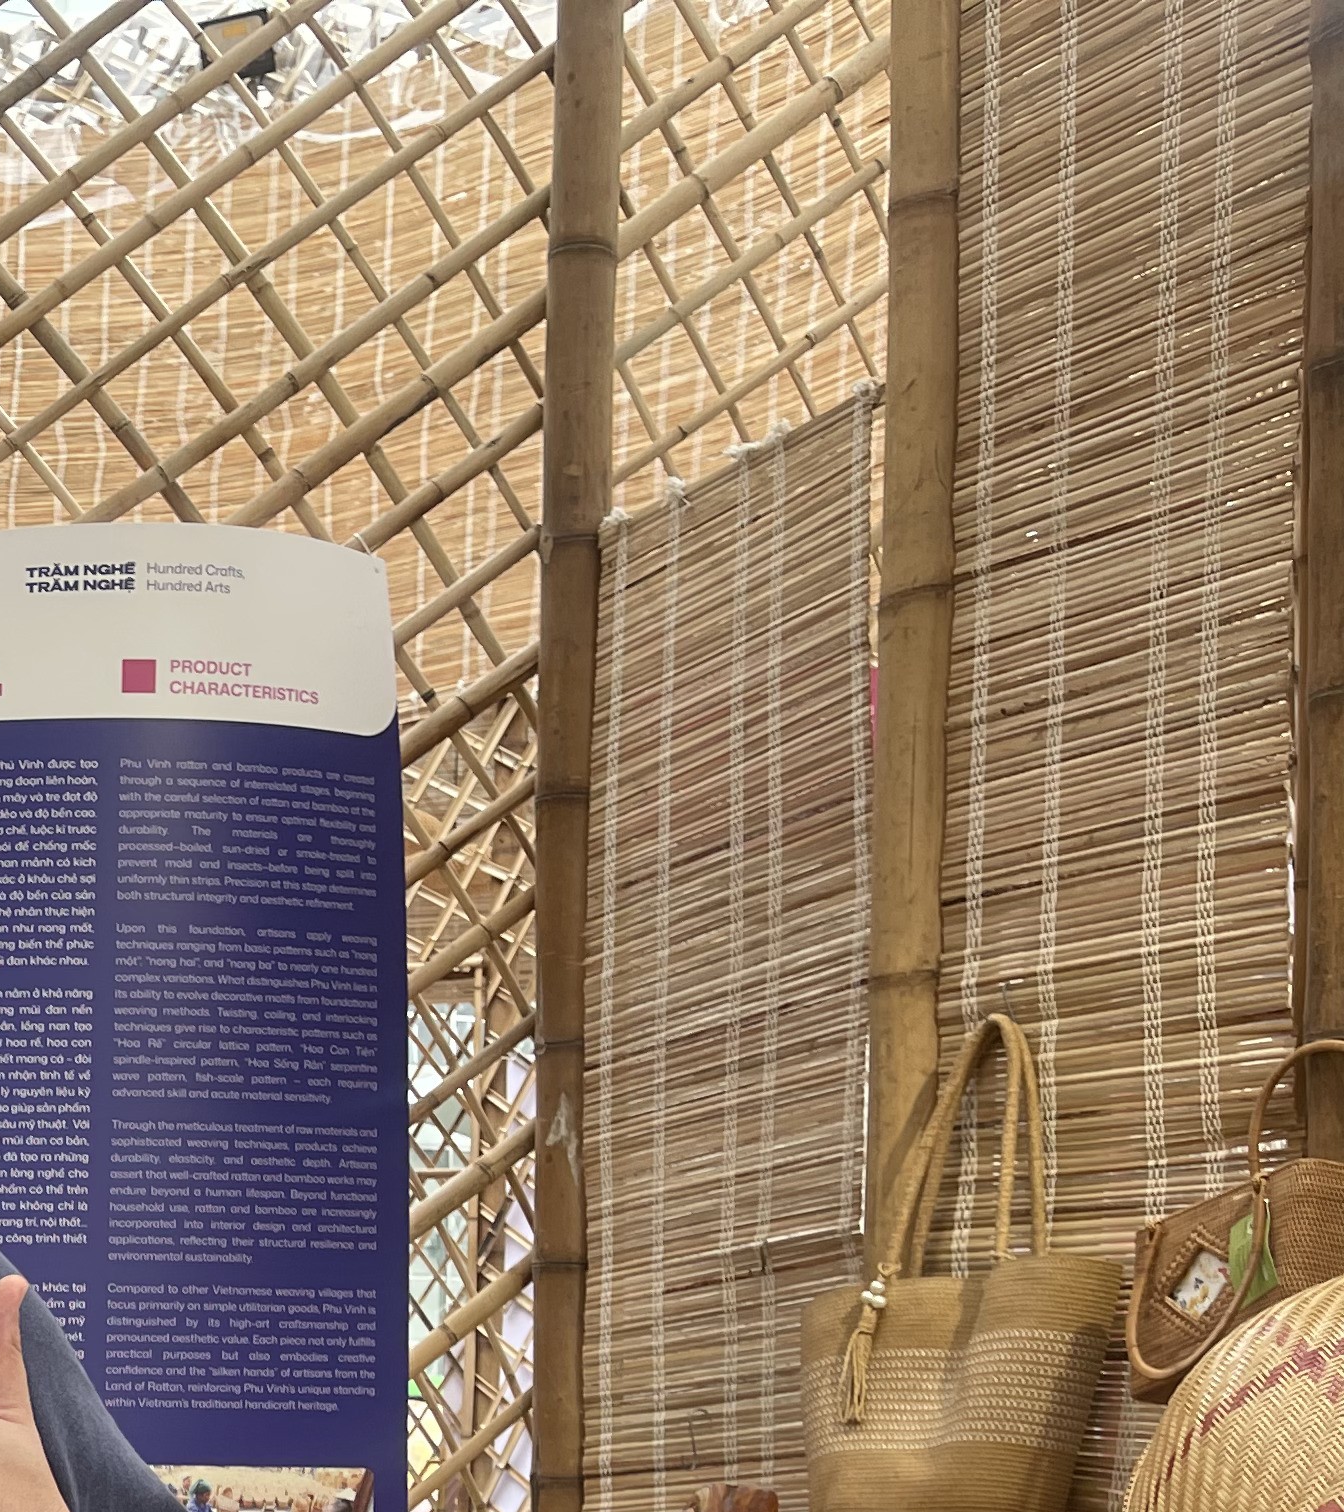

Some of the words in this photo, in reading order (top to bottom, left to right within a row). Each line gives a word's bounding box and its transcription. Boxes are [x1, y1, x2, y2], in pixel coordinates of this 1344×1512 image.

[26, 563, 79, 578] TRĂM
[146, 562, 203, 576] Hundred
[206, 564, 245, 579] Crafts,
[26, 578, 79, 593] TRĂM
[146, 580, 202, 592] Hundred
[205, 580, 230, 594] Arts
[170, 659, 252, 676] PRODUCT
[169, 680, 318, 704] CHARACTERISTICS
[19, 759, 44, 770] Vinh
[120, 758, 142, 769] Phu
[147, 758, 171, 769] Vinh
[177, 760, 207, 770] rattan
[212, 761, 232, 771] and
[237, 762, 278, 774] bamboo
[26, 1135, 47, 1145] đan
[107, 1282, 164, 1294] Compared
[168, 1284, 178, 1294] to
[182, 1284, 209, 1295] other
[212, 1284, 272, 1297] Vietnamese
[275, 1288, 315, 1299] weaving
[318, 1287, 353, 1300] villages
[356, 1289, 376, 1299] that
[107, 1299, 136, 1310] focus
[139, 1301, 185, 1312] primarily
[187, 1302, 200, 1311] on
[204, 1301, 237, 1312] simple
[239, 1302, 285, 1312] utilitarian
[323, 1303, 342, 1314] Phu
[344, 1304, 366, 1314] Vinh
[368, 1305, 376, 1315] is
[107, 1316, 177, 1328] distinguished
[186, 1317, 198, 1329] by
[208, 1317, 220, 1328] its
[230, 1317, 270, 1330] high-art
[279, 1319, 348, 1332] craftsmanship
[357, 1321, 376, 1331] and
[107, 1333, 169, 1343] pronounced
[172, 1334, 219, 1344] aesthetic
[253, 1335, 278, 1345] Each
[280, 1335, 306, 1346] piece
[308, 1337, 324, 1346] not
[327, 1336, 347, 1348] only
[349, 1336, 376, 1347] fulfills
